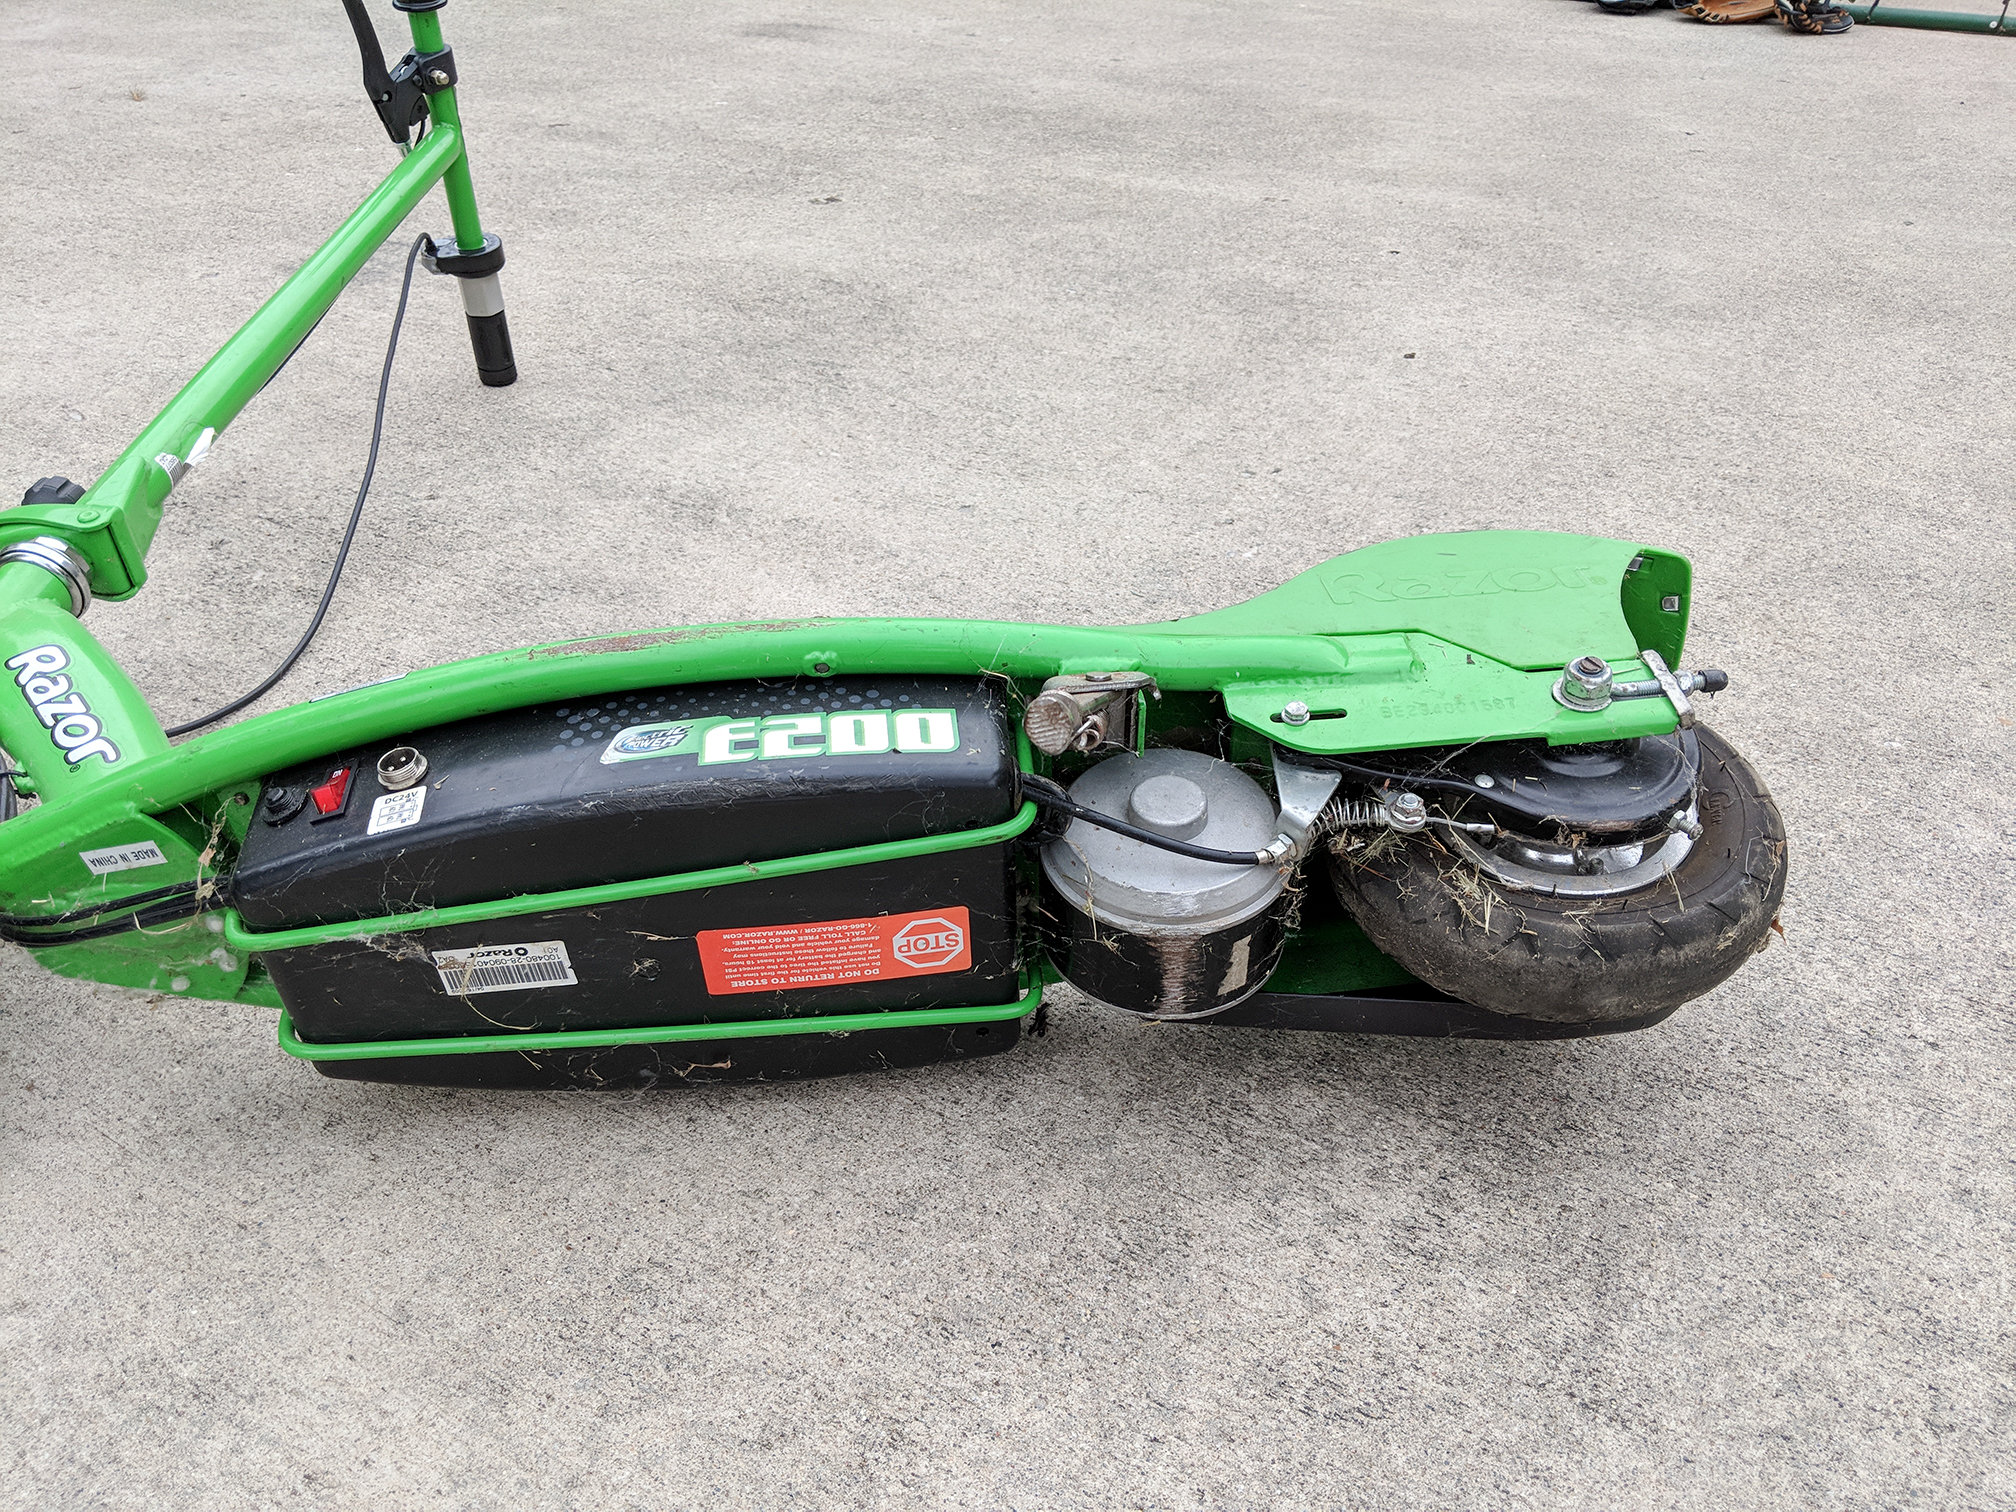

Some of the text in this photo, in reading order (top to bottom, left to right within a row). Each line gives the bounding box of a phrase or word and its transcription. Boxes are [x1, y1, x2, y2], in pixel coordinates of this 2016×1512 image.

[1320, 565, 1591, 605] Razor
[4, 644, 121, 765] Razor
[626, 734, 688, 748] POWER
[699, 710, 959, 765] E200
[385, 791, 418, 804] DC24V
[88, 848, 159, 868] MADE IN CHINA
[723, 929, 798, 939] WWW.RAZOR.COM
[805, 923, 872, 933] 1-866-GO-RAZOR
[897, 931, 960, 954] STOP
[467, 949, 512, 958] Razor
[731, 979, 768, 987] STORE
[790, 973, 834, 982] RETURN
